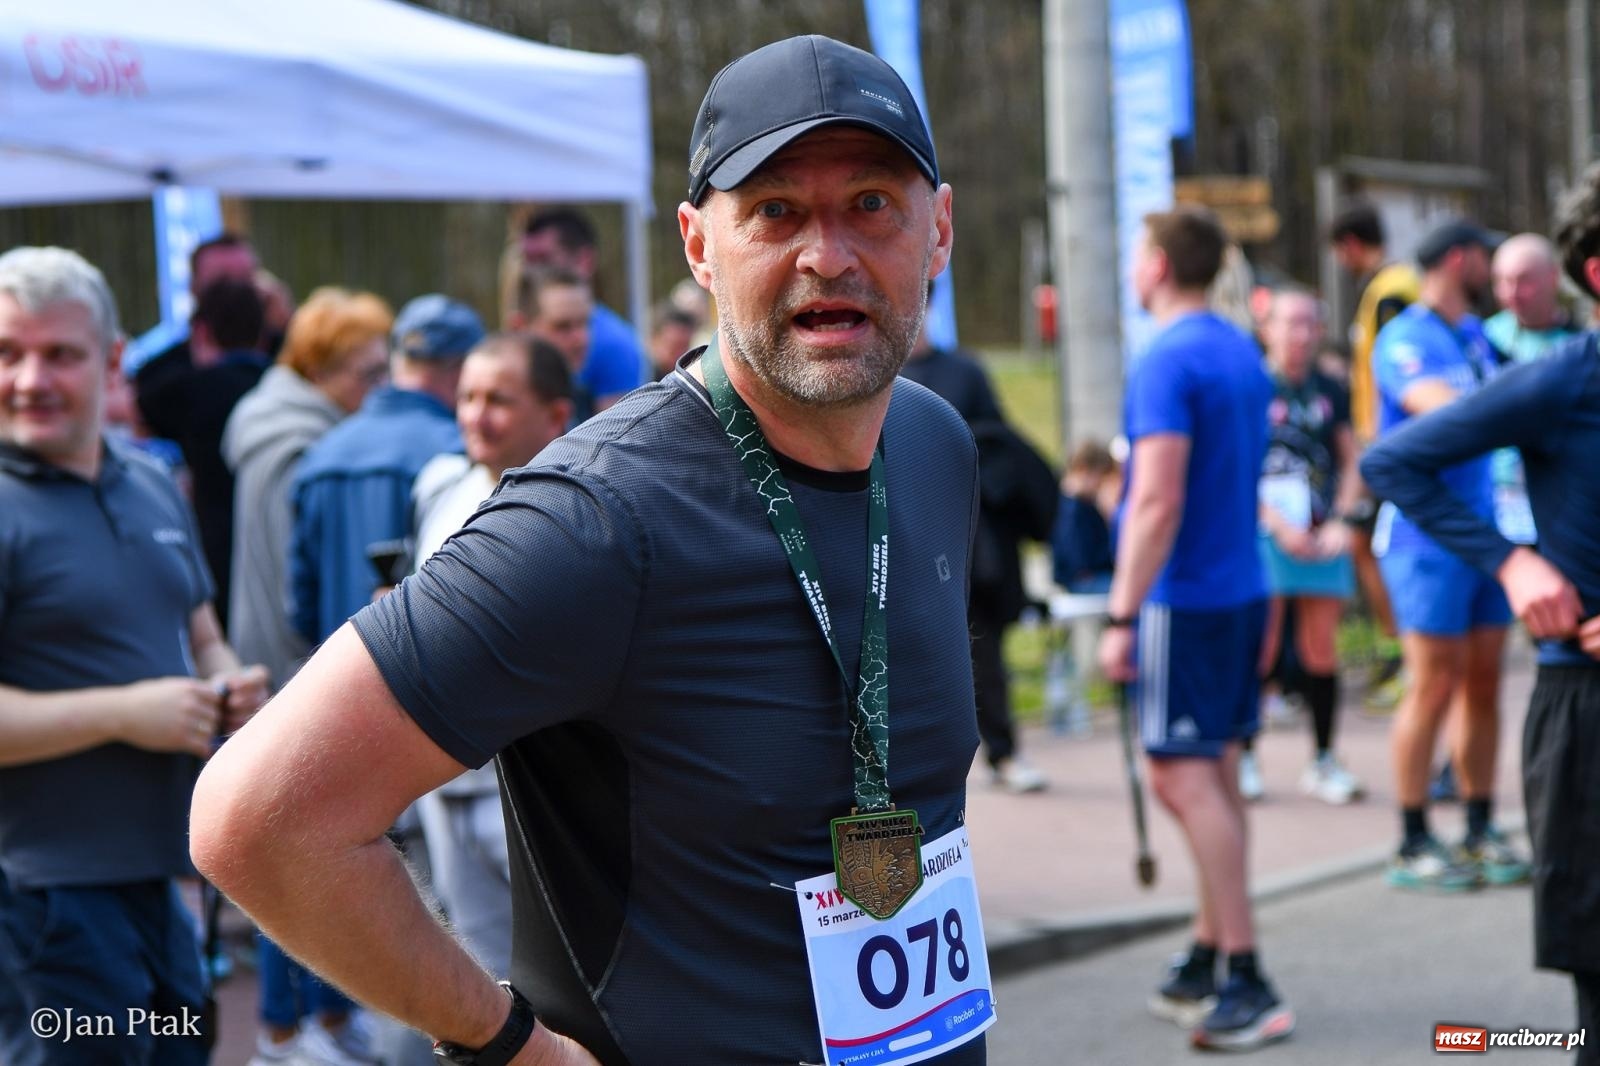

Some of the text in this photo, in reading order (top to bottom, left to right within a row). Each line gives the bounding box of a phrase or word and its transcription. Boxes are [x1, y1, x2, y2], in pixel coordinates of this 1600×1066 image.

[871, 571, 880, 594] XIV
[878, 534, 888, 610] TWARDZIELA
[799, 570, 832, 646] TWARDZIELA
[812, 580, 832, 631] XIV BIEG
[846, 825, 924, 841] TWARDZIELA
[856, 817, 908, 830] XIV BIEG
[923, 844, 962, 879] ARDZIELA
[818, 915, 830, 927] 15
[857, 908, 970, 1010] 078
